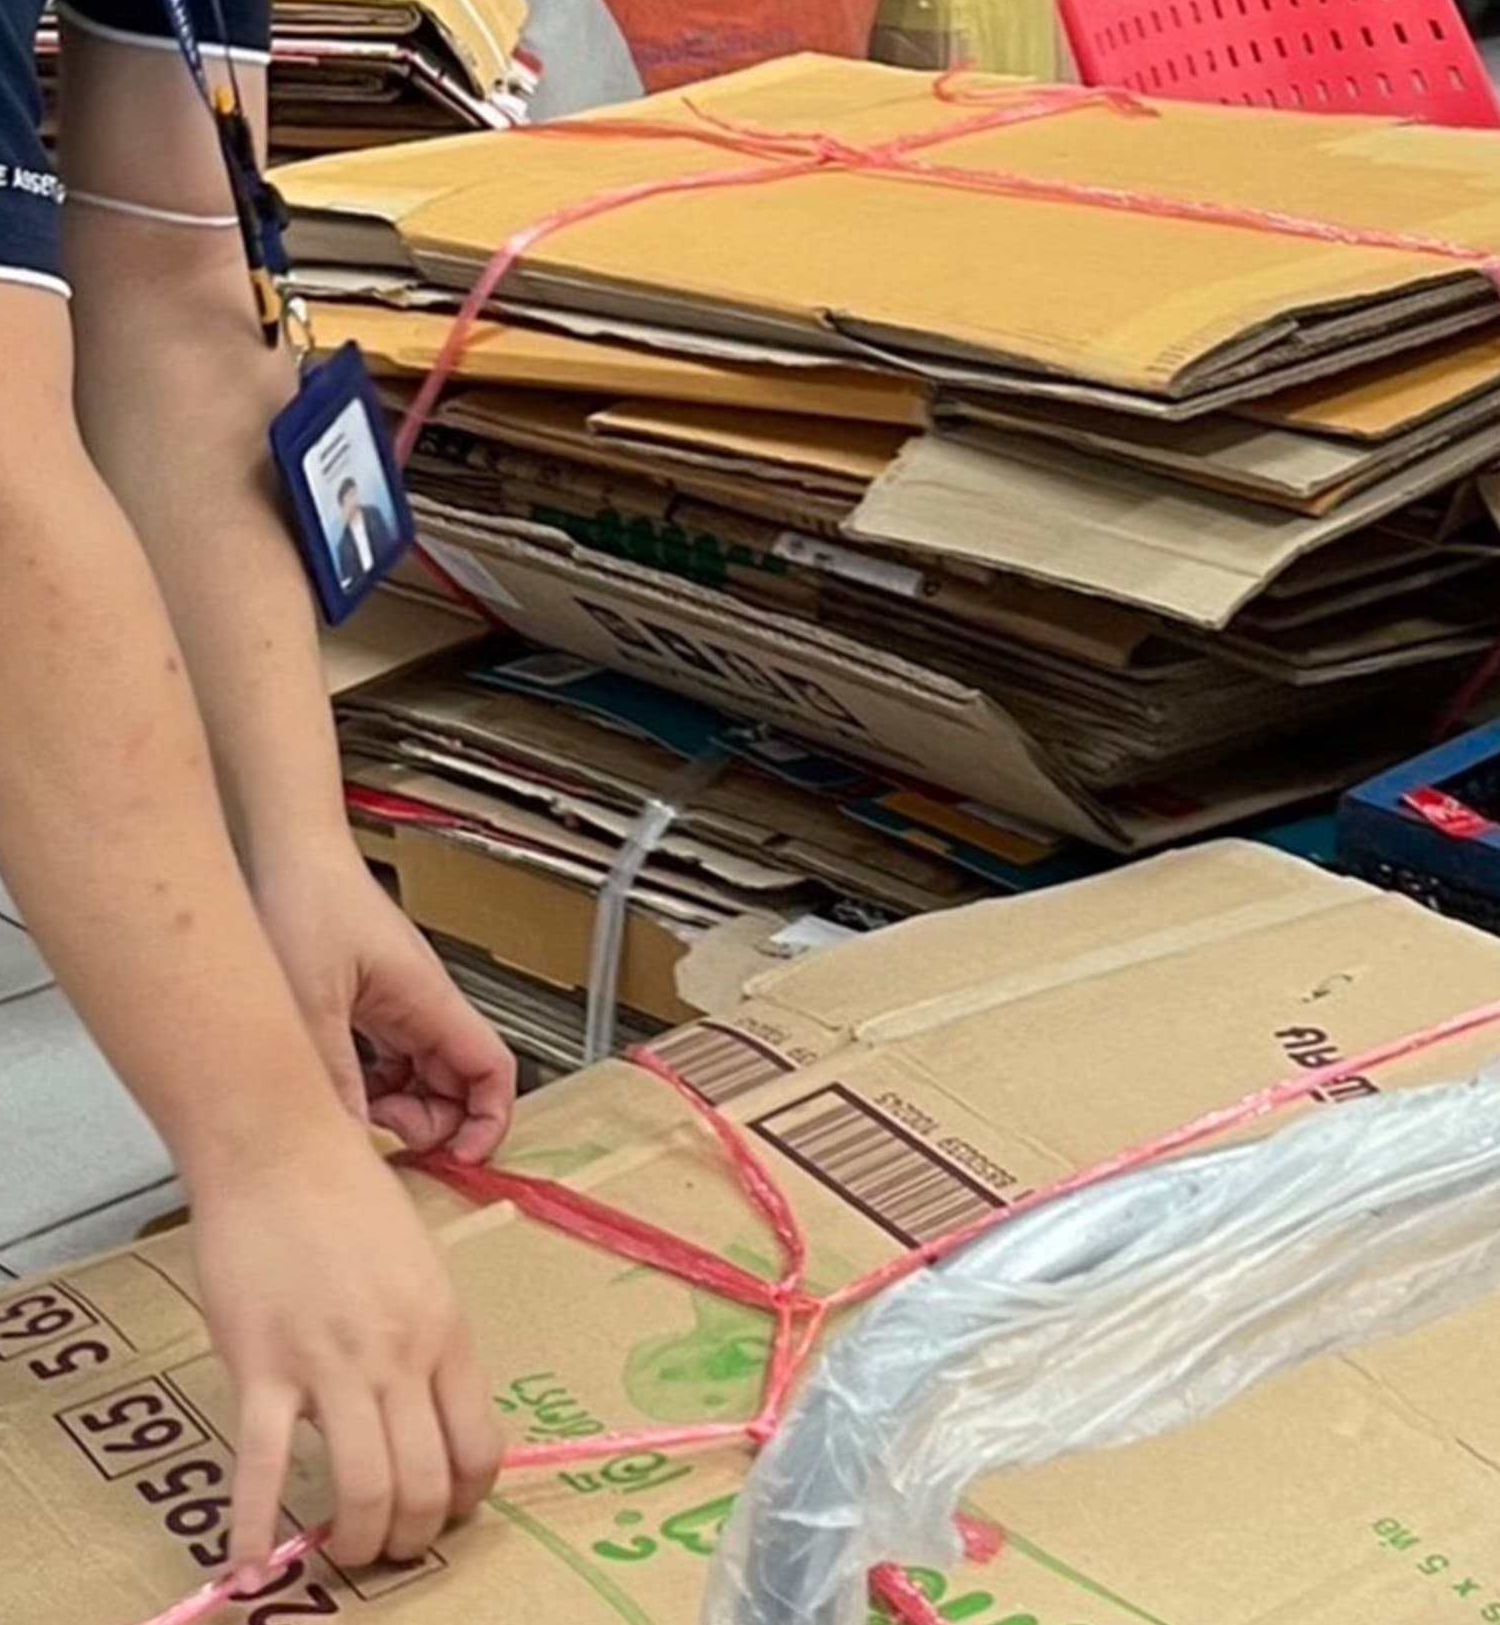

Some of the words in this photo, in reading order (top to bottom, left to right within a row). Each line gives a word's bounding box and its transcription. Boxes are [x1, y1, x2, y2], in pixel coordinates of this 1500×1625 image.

[29, 1340, 110, 1382] 5
[78, 1391, 186, 1458] 65
[1417, 1552, 1450, 1578] 5
[1452, 1576, 1481, 1599] x
